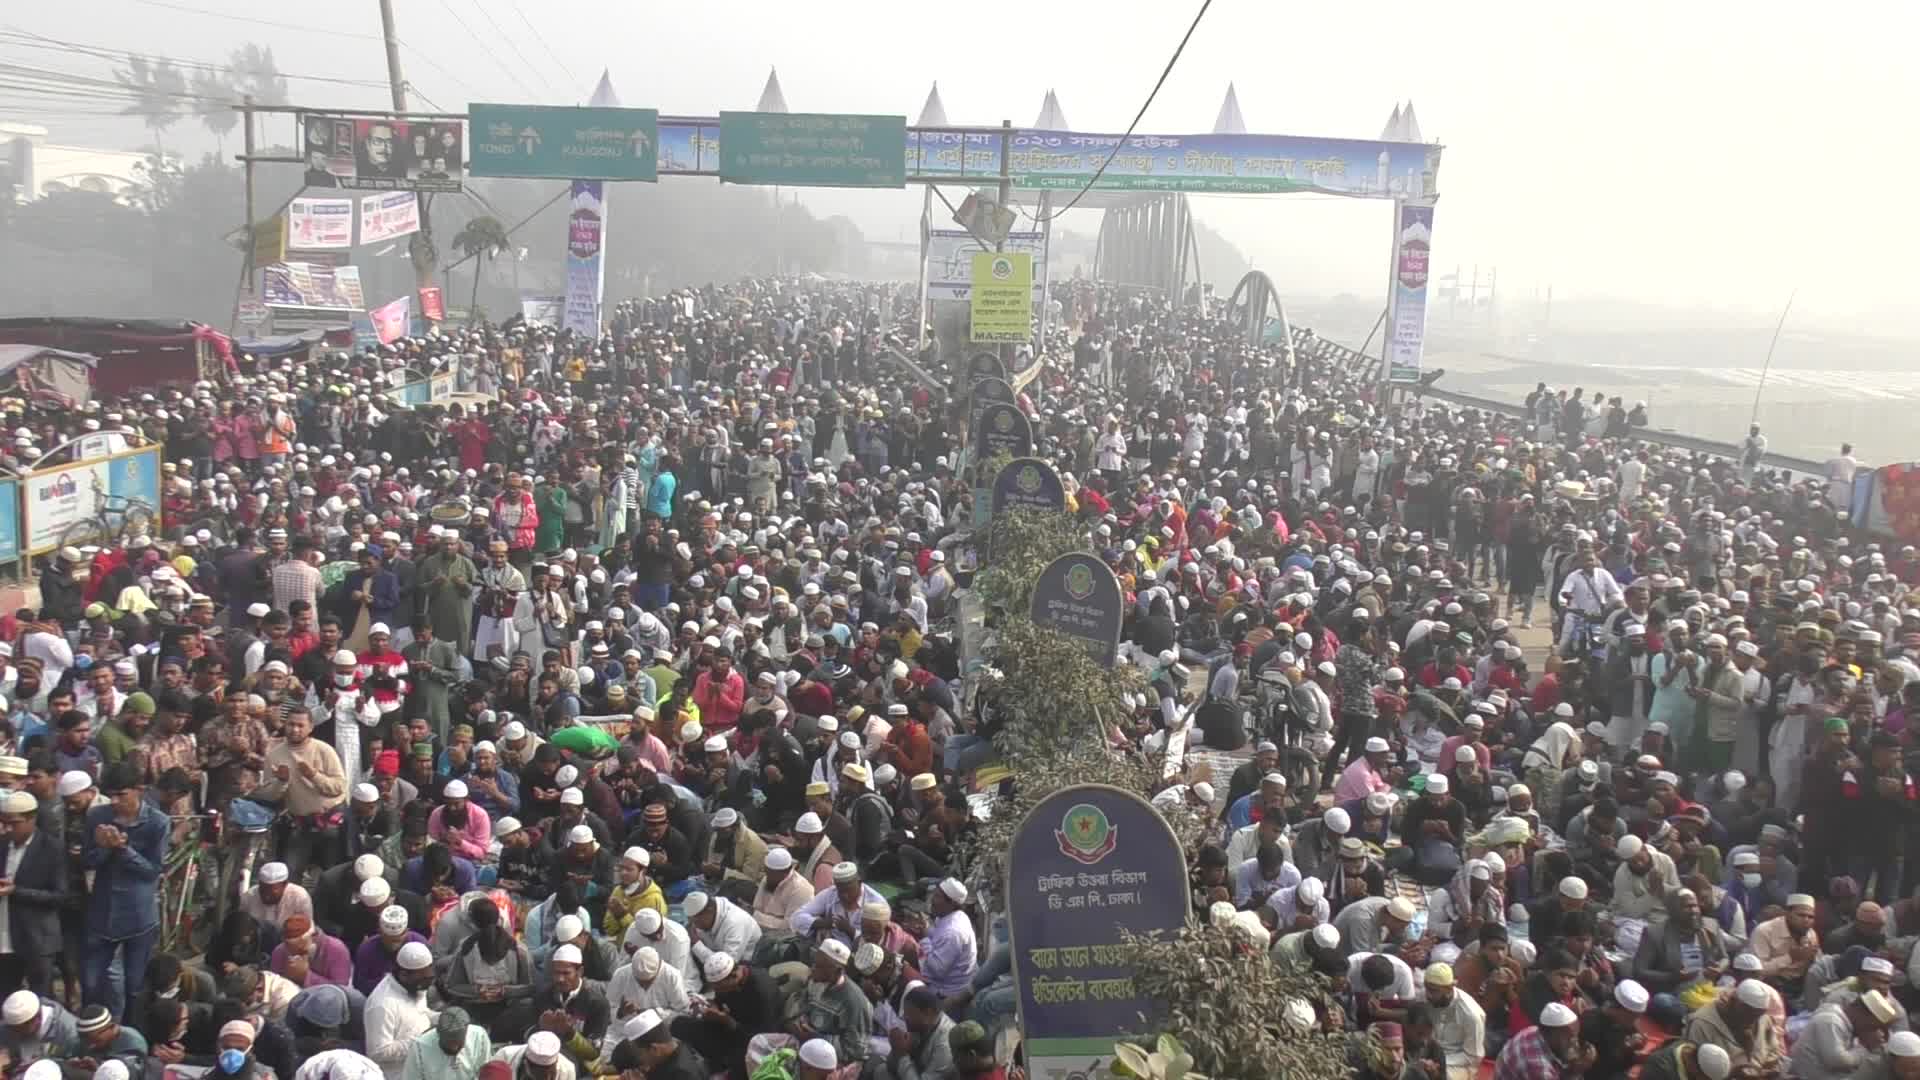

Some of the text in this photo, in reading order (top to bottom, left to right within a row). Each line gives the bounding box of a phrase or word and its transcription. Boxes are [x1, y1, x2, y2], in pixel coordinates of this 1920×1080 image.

[1167, 156, 1178, 168] ও
[1037, 869, 1148, 892] ট্রাফিক উত্তরা বিভাগ
[1048, 893, 1062, 910] ডি
[1065, 897, 1085, 908] এম
[1030, 948, 1057, 969] বামে
[1060, 946, 1089, 968] ডানে
